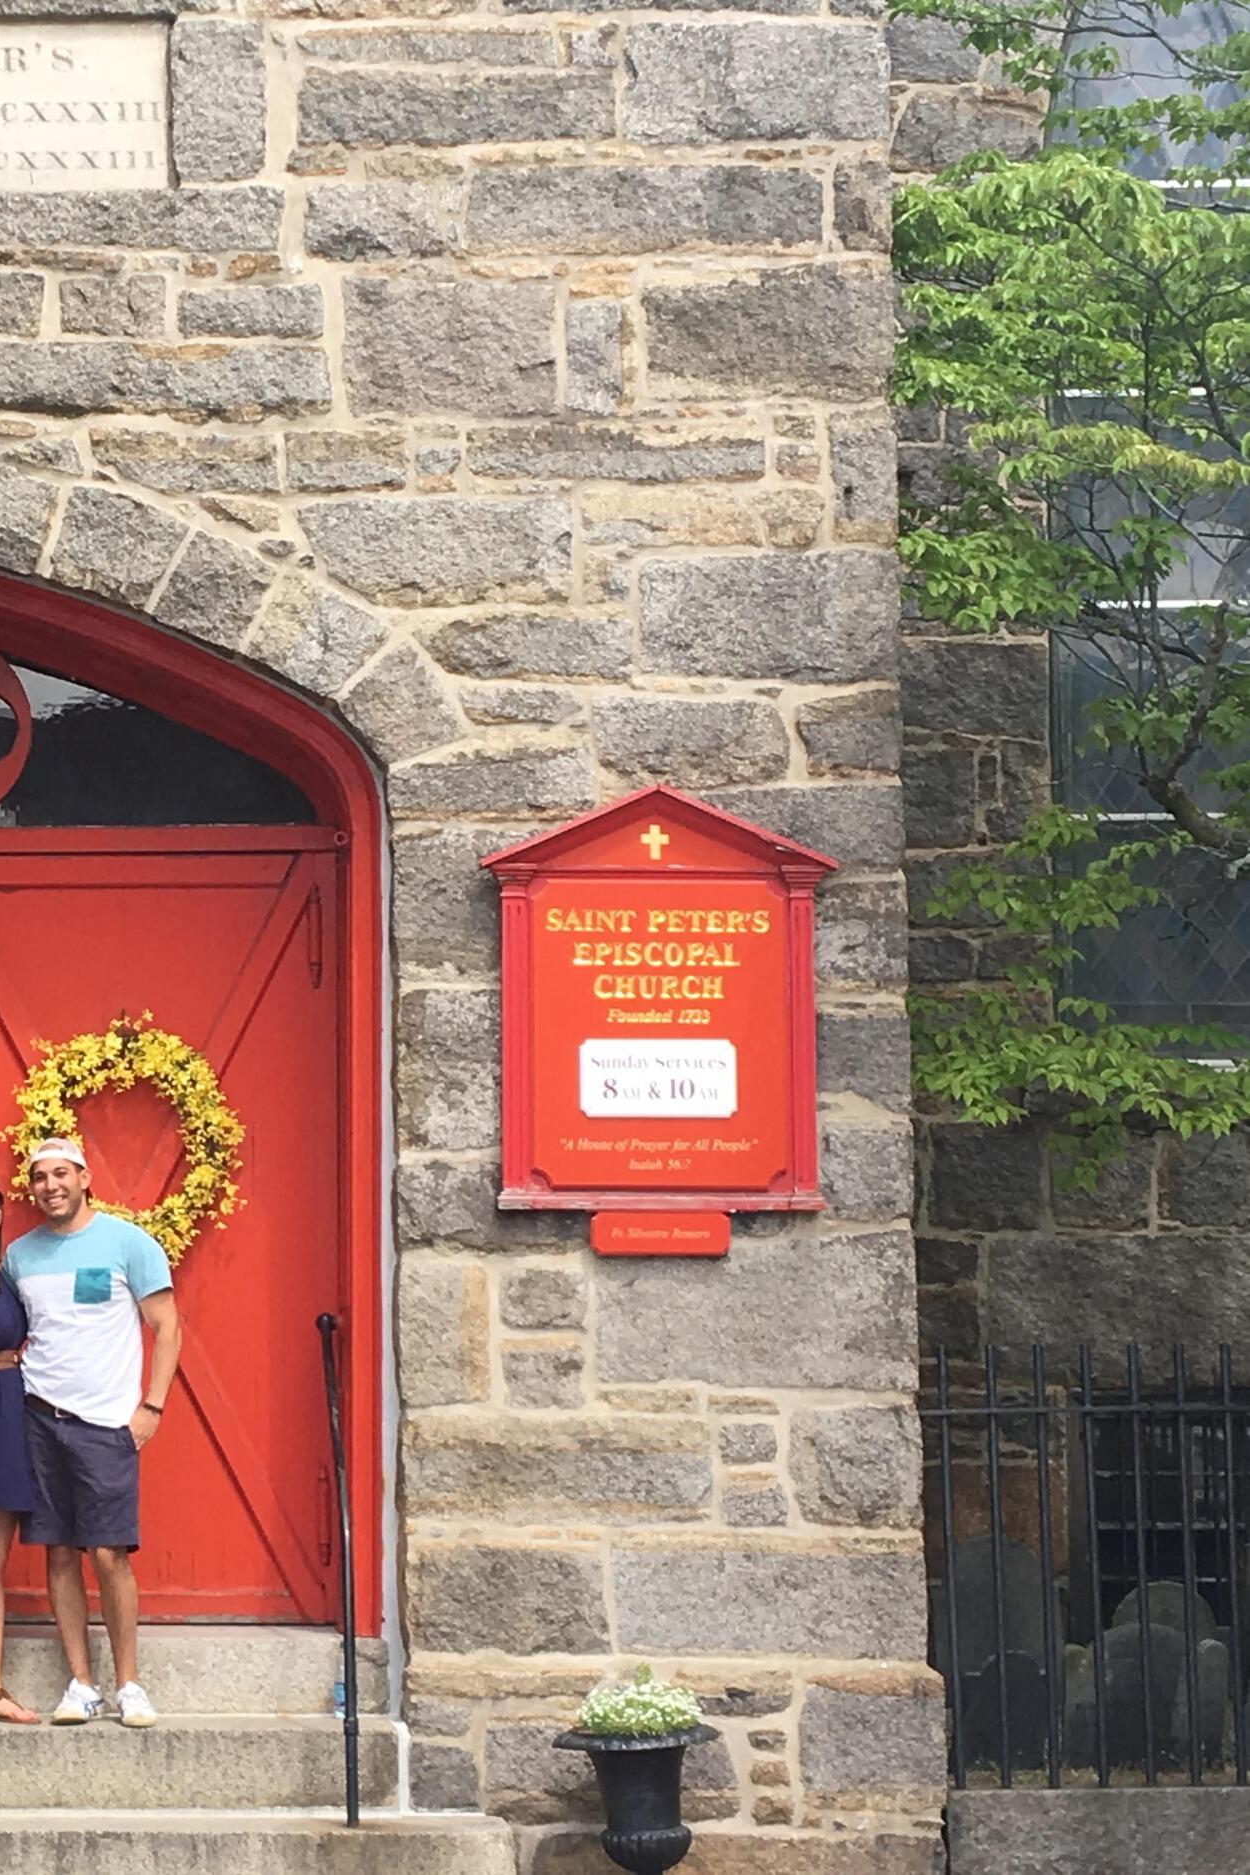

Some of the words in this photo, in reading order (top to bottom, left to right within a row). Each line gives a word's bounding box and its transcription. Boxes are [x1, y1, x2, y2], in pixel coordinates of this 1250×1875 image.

[545, 908, 637, 932] SAINT
[647, 909, 770, 933] PETER'S
[572, 941, 741, 966] EPISCOPAL
[593, 974, 724, 999] CHURCH
[606, 1008, 673, 1023] Founded
[591, 1055, 649, 1070] Sunday
[655, 1056, 727, 1069] Services
